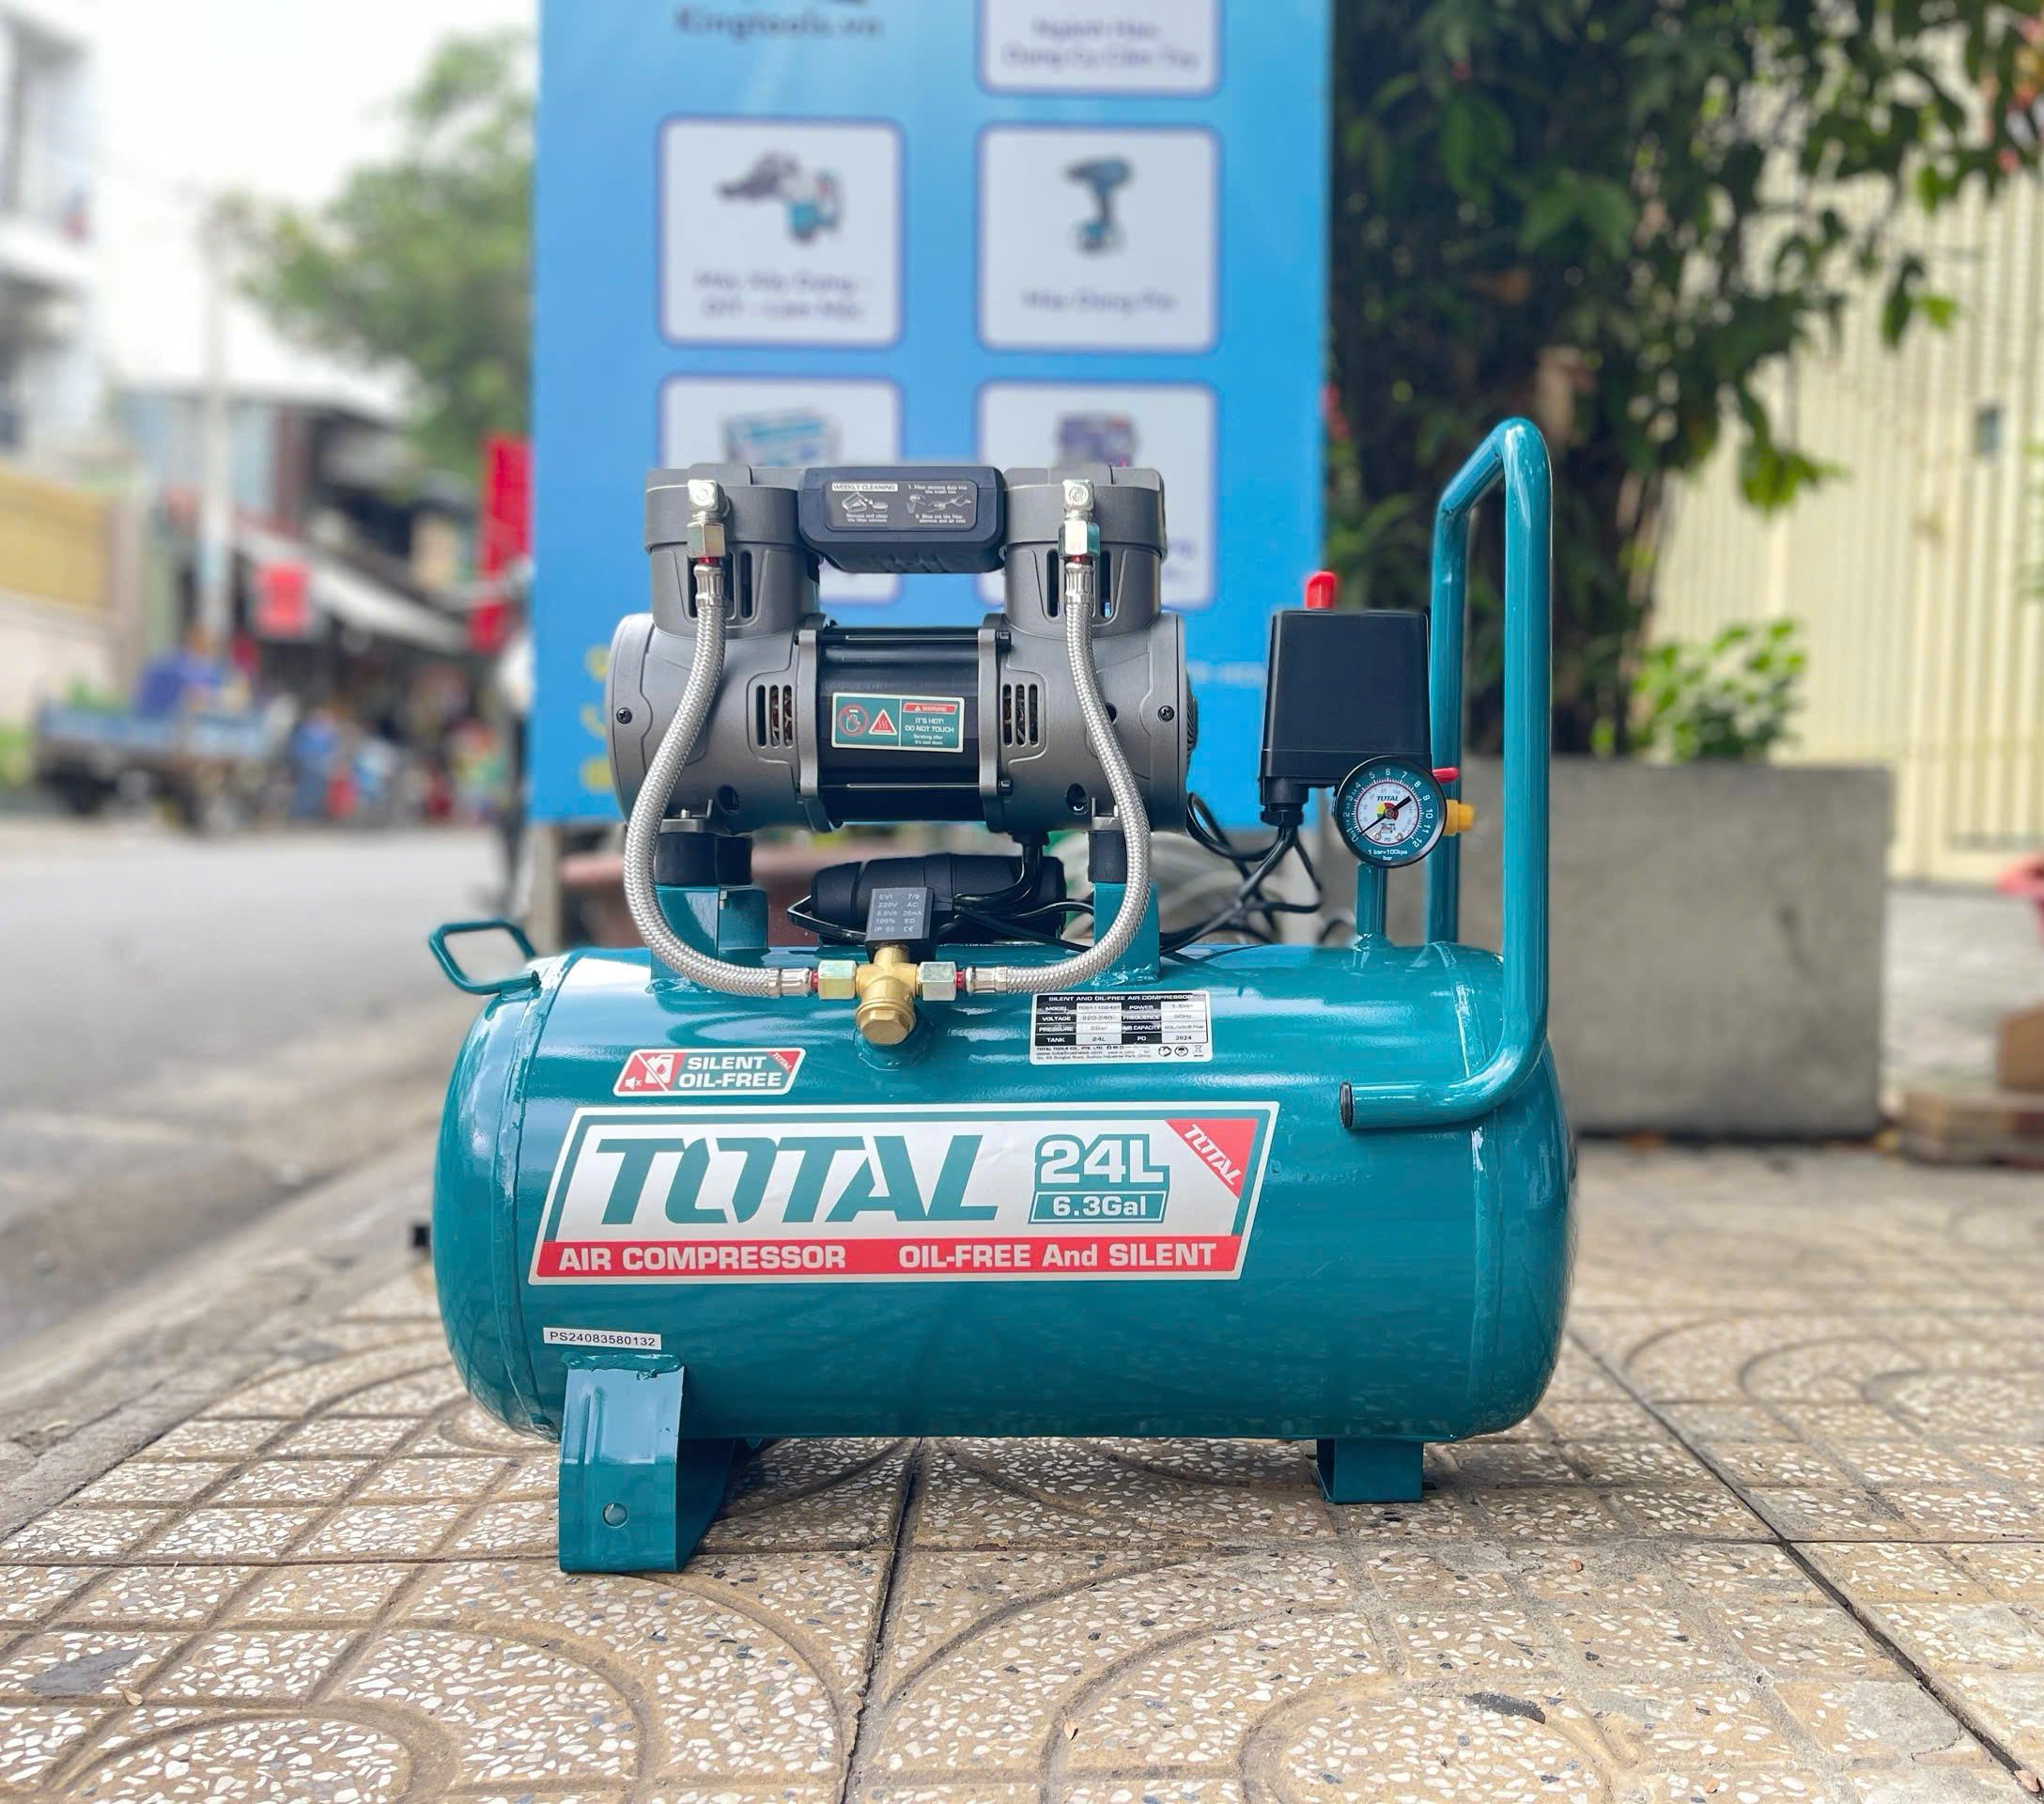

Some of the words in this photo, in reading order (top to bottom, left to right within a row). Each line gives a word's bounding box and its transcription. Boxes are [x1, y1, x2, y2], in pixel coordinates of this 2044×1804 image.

[1425, 809, 1433, 819] 10
[1422, 825, 1431, 833] 11
[1412, 838, 1422, 848] 12
[687, 1056, 766, 1070] SILENT
[772, 1052, 793, 1070] TOTAL
[678, 1072, 782, 1088] OIL-FREE
[1038, 1136, 1167, 1187] 24L
[1182, 1124, 1244, 1187] TOTAL
[596, 1134, 999, 1225] TOTAL
[1052, 1195, 1147, 1217] 6.3Gal
[558, 1247, 612, 1271] AIR
[622, 1245, 845, 1270] COMPRESSOR
[899, 1244, 1031, 1269] OIL-FREE
[1042, 1244, 1098, 1267] And
[1109, 1243, 1217, 1267] SILENT
[550, 1331, 656, 1346] PS24083580132
